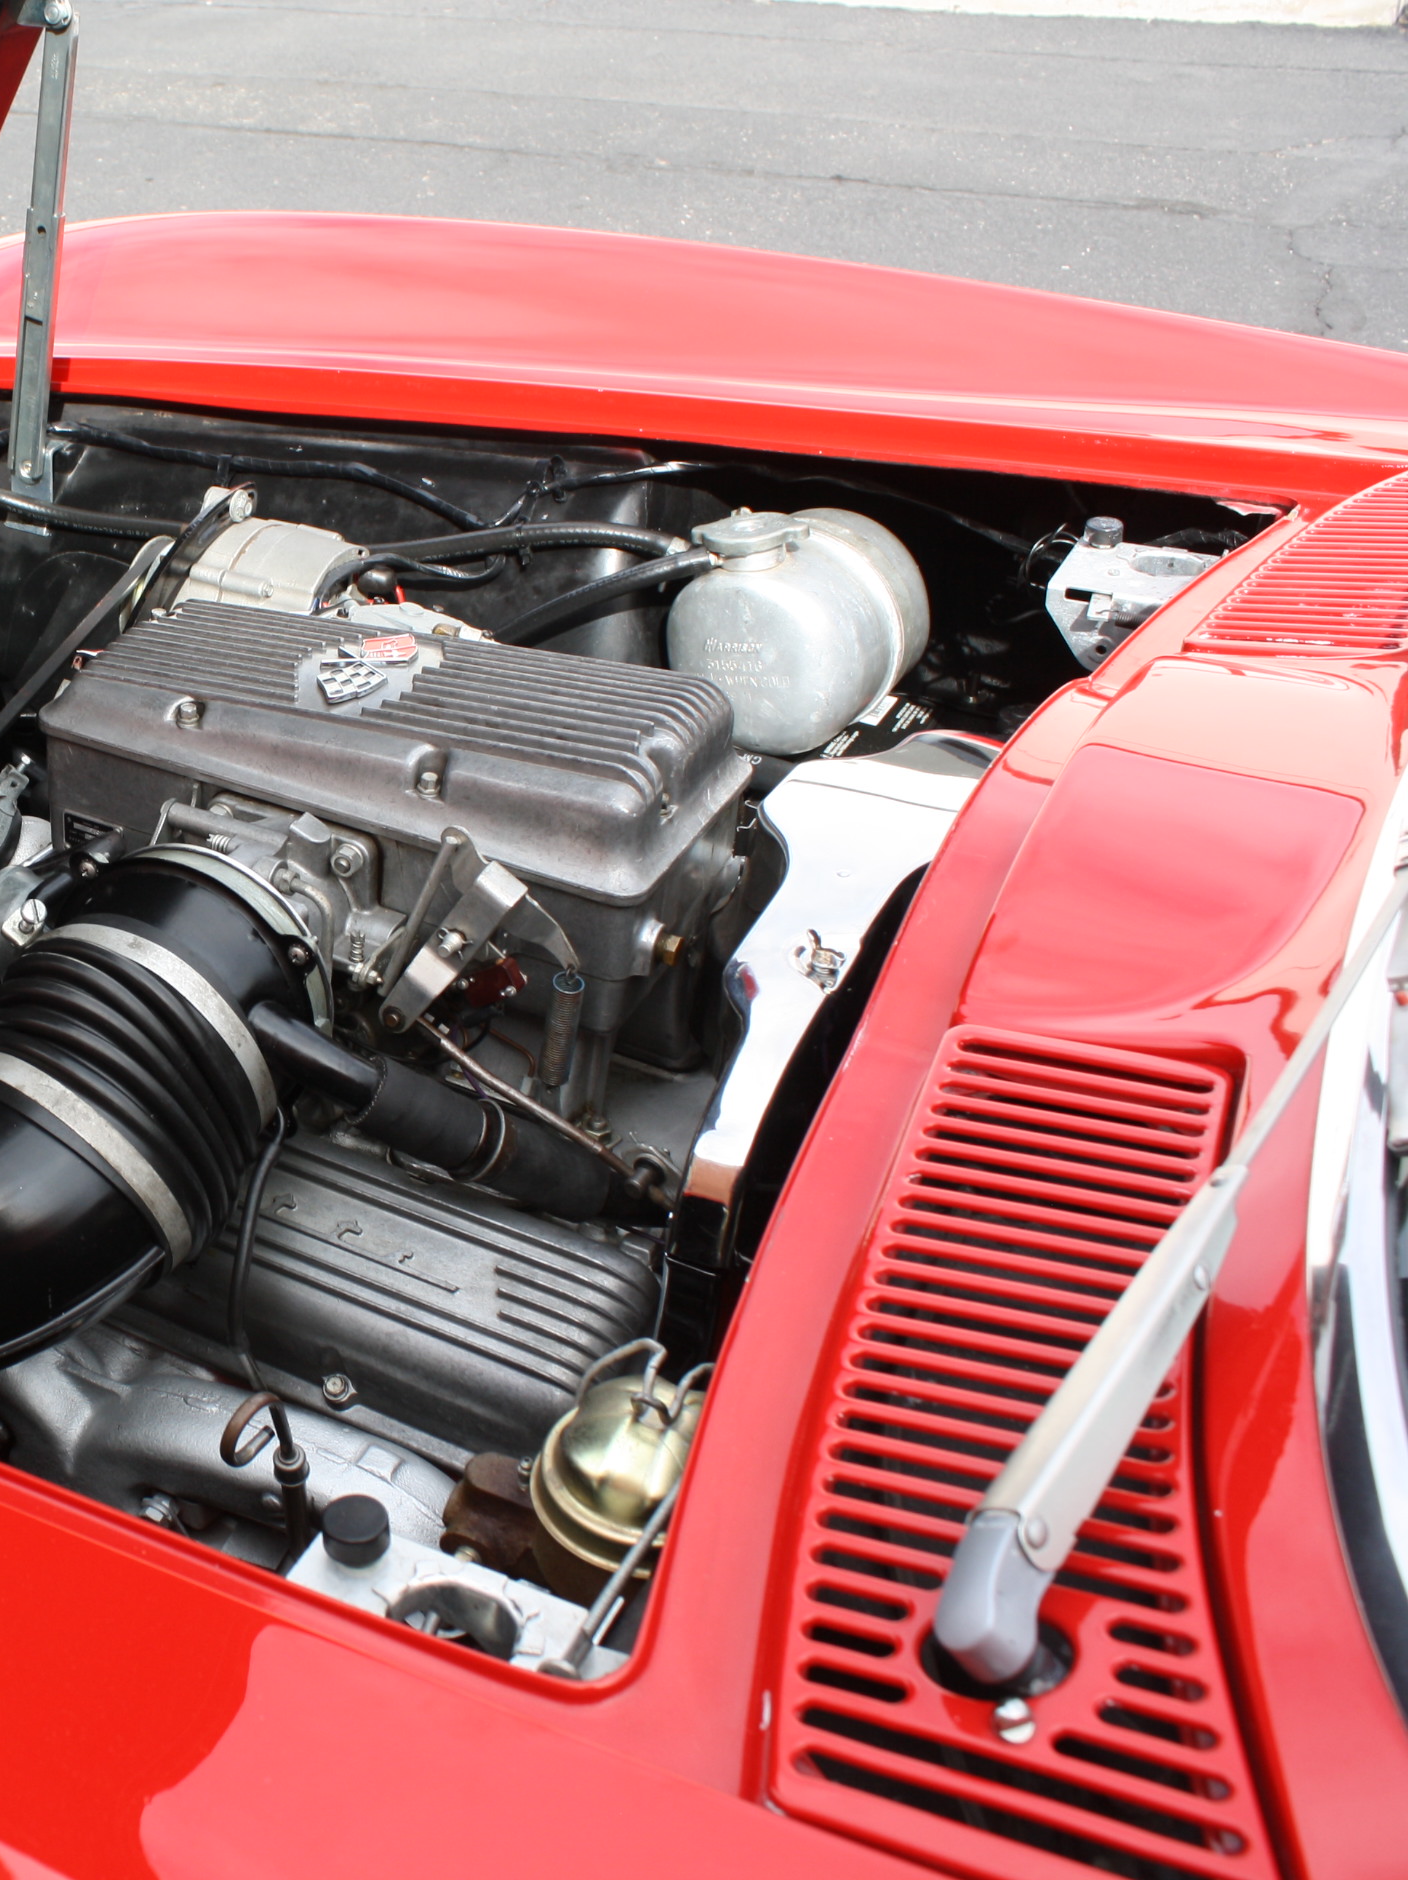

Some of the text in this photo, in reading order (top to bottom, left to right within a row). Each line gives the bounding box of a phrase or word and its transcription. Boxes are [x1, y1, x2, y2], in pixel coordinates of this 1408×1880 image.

[704, 637, 764, 654] HARRISON
[724, 674, 759, 688] WHEN
[760, 675, 791, 689] COLD
